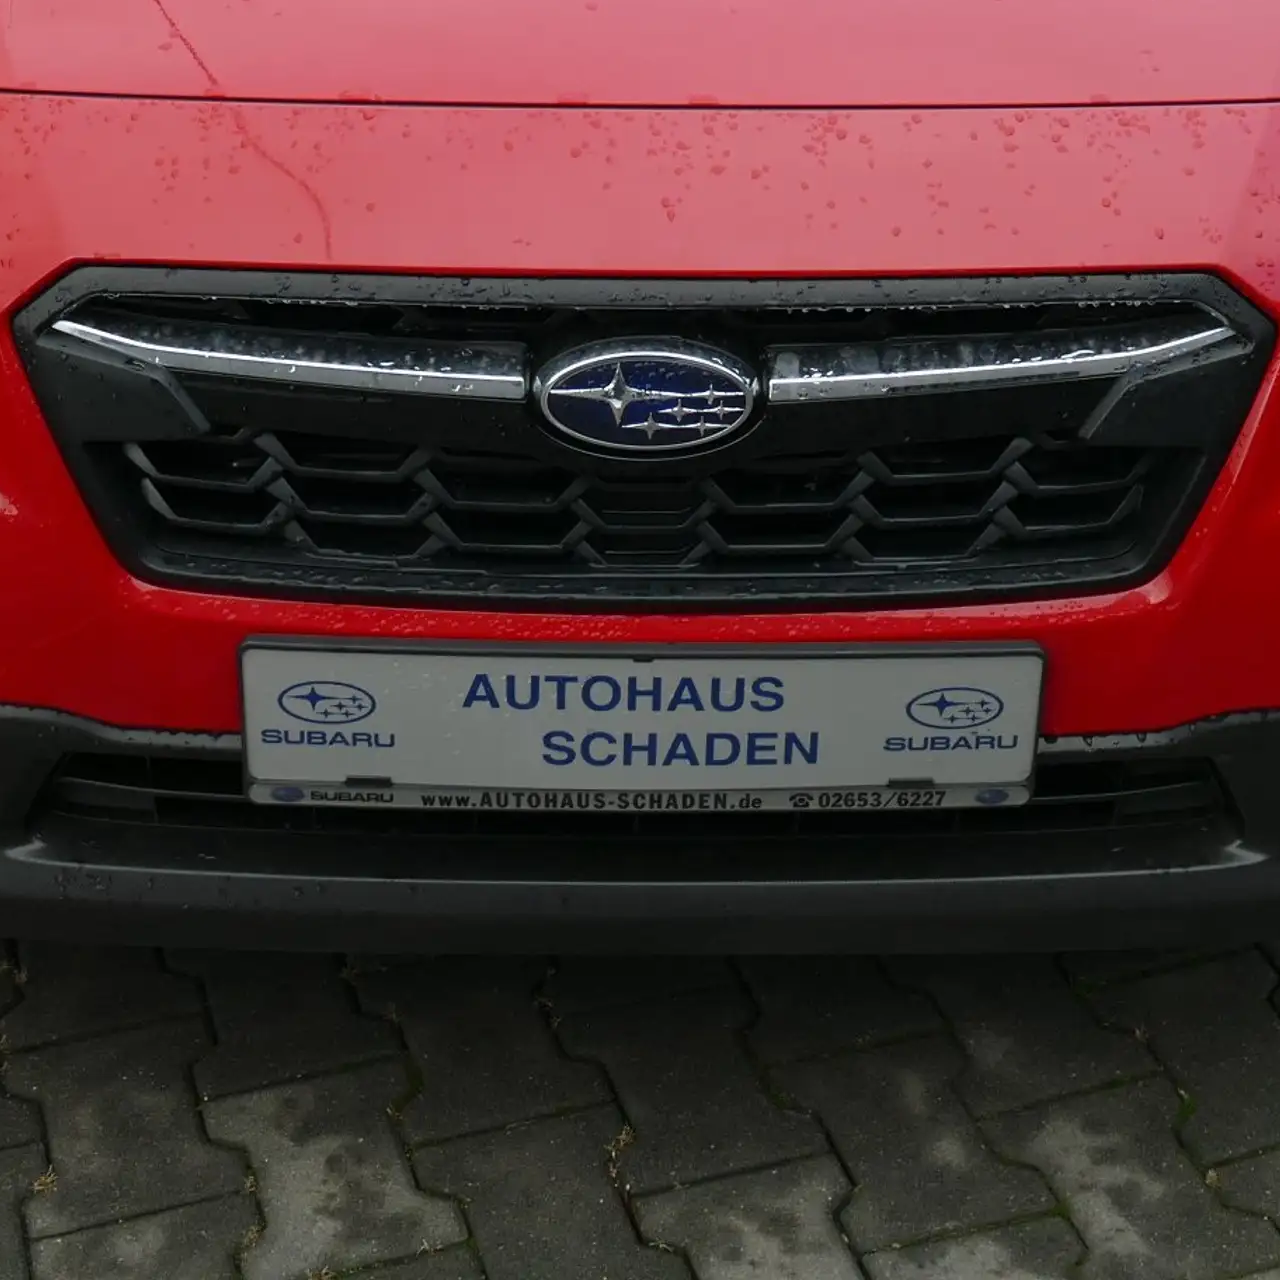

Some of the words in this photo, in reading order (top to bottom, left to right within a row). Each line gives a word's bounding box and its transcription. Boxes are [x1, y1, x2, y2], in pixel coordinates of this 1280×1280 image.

[462, 673, 785, 713] AUTOHAUS
[261, 729, 396, 748] SUBARU
[883, 734, 1019, 752] SUBARU
[541, 730, 820, 767] SCHADEN
[310, 790, 394, 804] SUBARU
[420, 791, 763, 810] www.AUTOHAUS-SCHADEN.de
[818, 790, 947, 809] 02653/6227
